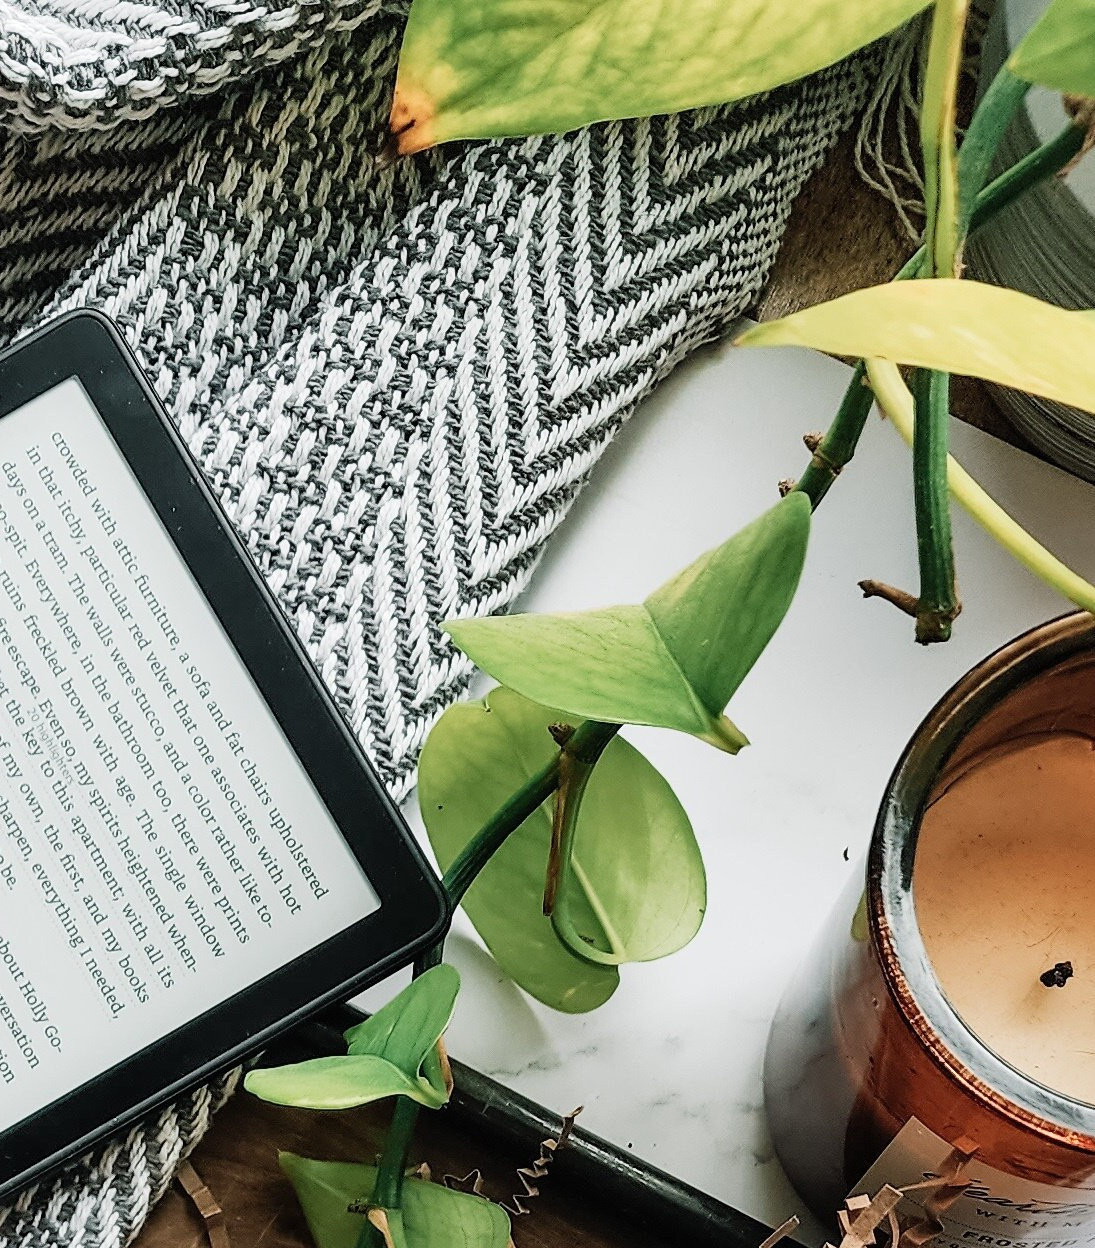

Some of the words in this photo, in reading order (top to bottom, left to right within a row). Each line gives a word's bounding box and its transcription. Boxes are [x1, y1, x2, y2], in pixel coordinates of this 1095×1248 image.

[1, 462, 27, 497] days
[23, 498, 40, 521] on
[42, 530, 69, 575] tram.
[67, 572, 90, 607] The
[86, 605, 114, 648] walls
[110, 646, 136, 687] were
[131, 686, 165, 742] stucco,
[163, 741, 189, 774] and
[188, 785, 217, 825] color
[210, 825, 245, 875] rather
[238, 872, 262, 907] like
[256, 904, 272, 929] to-
[7, 645, 41, 700] escape.
[37, 697, 65, 740] Even
[60, 738, 76, 763] so,
[73, 760, 95, 786] my
[88, 788, 123, 839] spirits
[116, 835, 175, 926] heightened
[167, 923, 197, 973] when-
[22, 614, 67, 679] freckled
[60, 676, 94, 733] brown
[92, 733, 119, 774] with
[115, 775, 136, 808] age.
[135, 808, 158, 843] The
[154, 845, 187, 893] single
[184, 893, 226, 958] window
[24, 558, 82, 655] Everywhere,
[79, 653, 95, 676] in
[91, 674, 112, 703] the
[107, 700, 155, 781] bathroom
[152, 780, 172, 813] too,
[171, 813, 199, 856] there
[195, 855, 222, 896] were
[213, 894, 250, 944] prints
[25, 445, 41, 466] in
[38, 465, 63, 501] that
[57, 499, 87, 545] itchy,
[79, 545, 134, 622] particular
[127, 623, 152, 652] red
[146, 650, 178, 700] velvet
[173, 698, 198, 735] that
[193, 735, 215, 766] one
[210, 766, 261, 845] associates
[257, 845, 284, 886] with
[278, 883, 302, 916] hot
[51, 432, 97, 498] crowded
[91, 498, 117, 538] with
[112, 538, 138, 575] attic
[133, 574, 180, 651] furniture,
[186, 665, 211, 700] sofa
[206, 700, 233, 733] and
[224, 732, 245, 758] fat
[240, 758, 272, 806] chairs
[268, 807, 330, 901] upholstered
[0, 863, 17, 891] be.
[962, 1230, 1079, 1248] FROSTED
